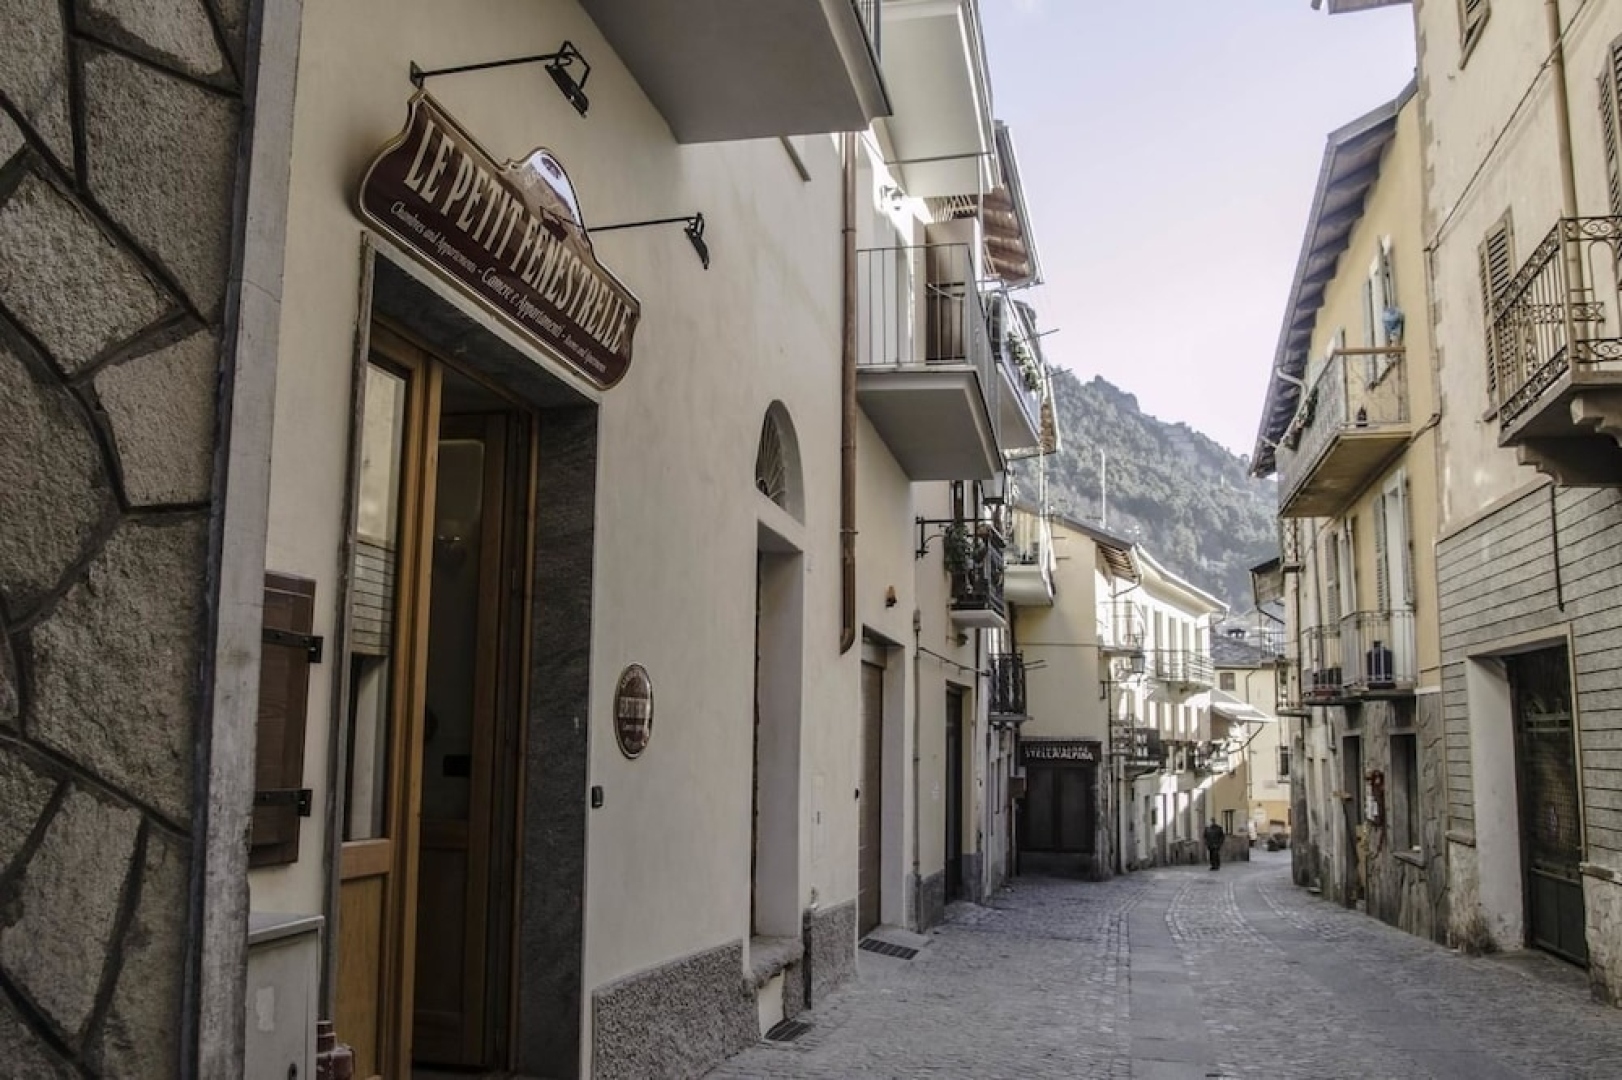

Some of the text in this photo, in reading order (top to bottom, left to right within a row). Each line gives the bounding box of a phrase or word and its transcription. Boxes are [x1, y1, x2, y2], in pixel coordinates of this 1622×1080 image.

[403, 119, 633, 355] LE PETIT FENESTRELLE
[1026, 750, 1060, 759] STELLA
